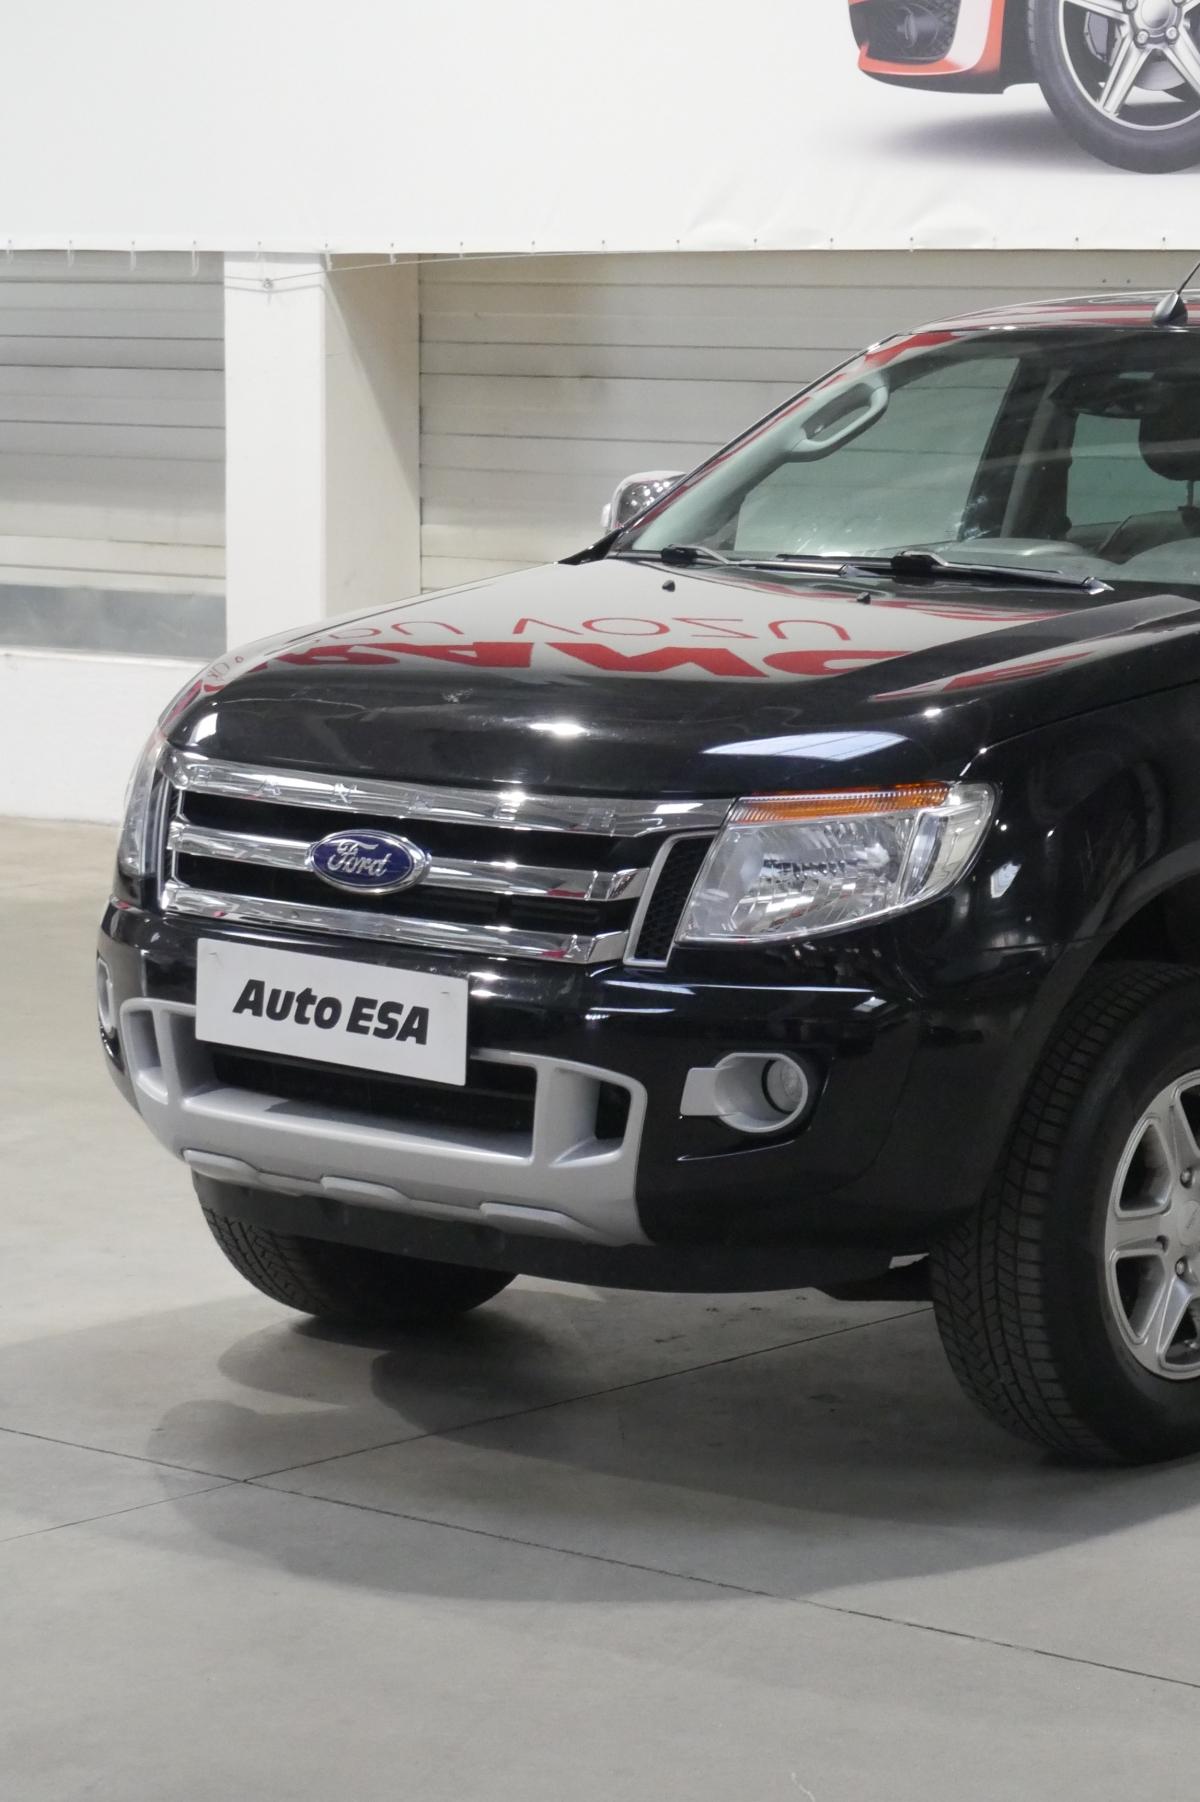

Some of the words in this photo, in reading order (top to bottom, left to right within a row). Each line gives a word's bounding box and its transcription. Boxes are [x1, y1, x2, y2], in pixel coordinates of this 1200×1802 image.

[327, 839, 392, 877] Ford
[232, 978, 342, 1030] Auto
[346, 996, 430, 1046] ESA
